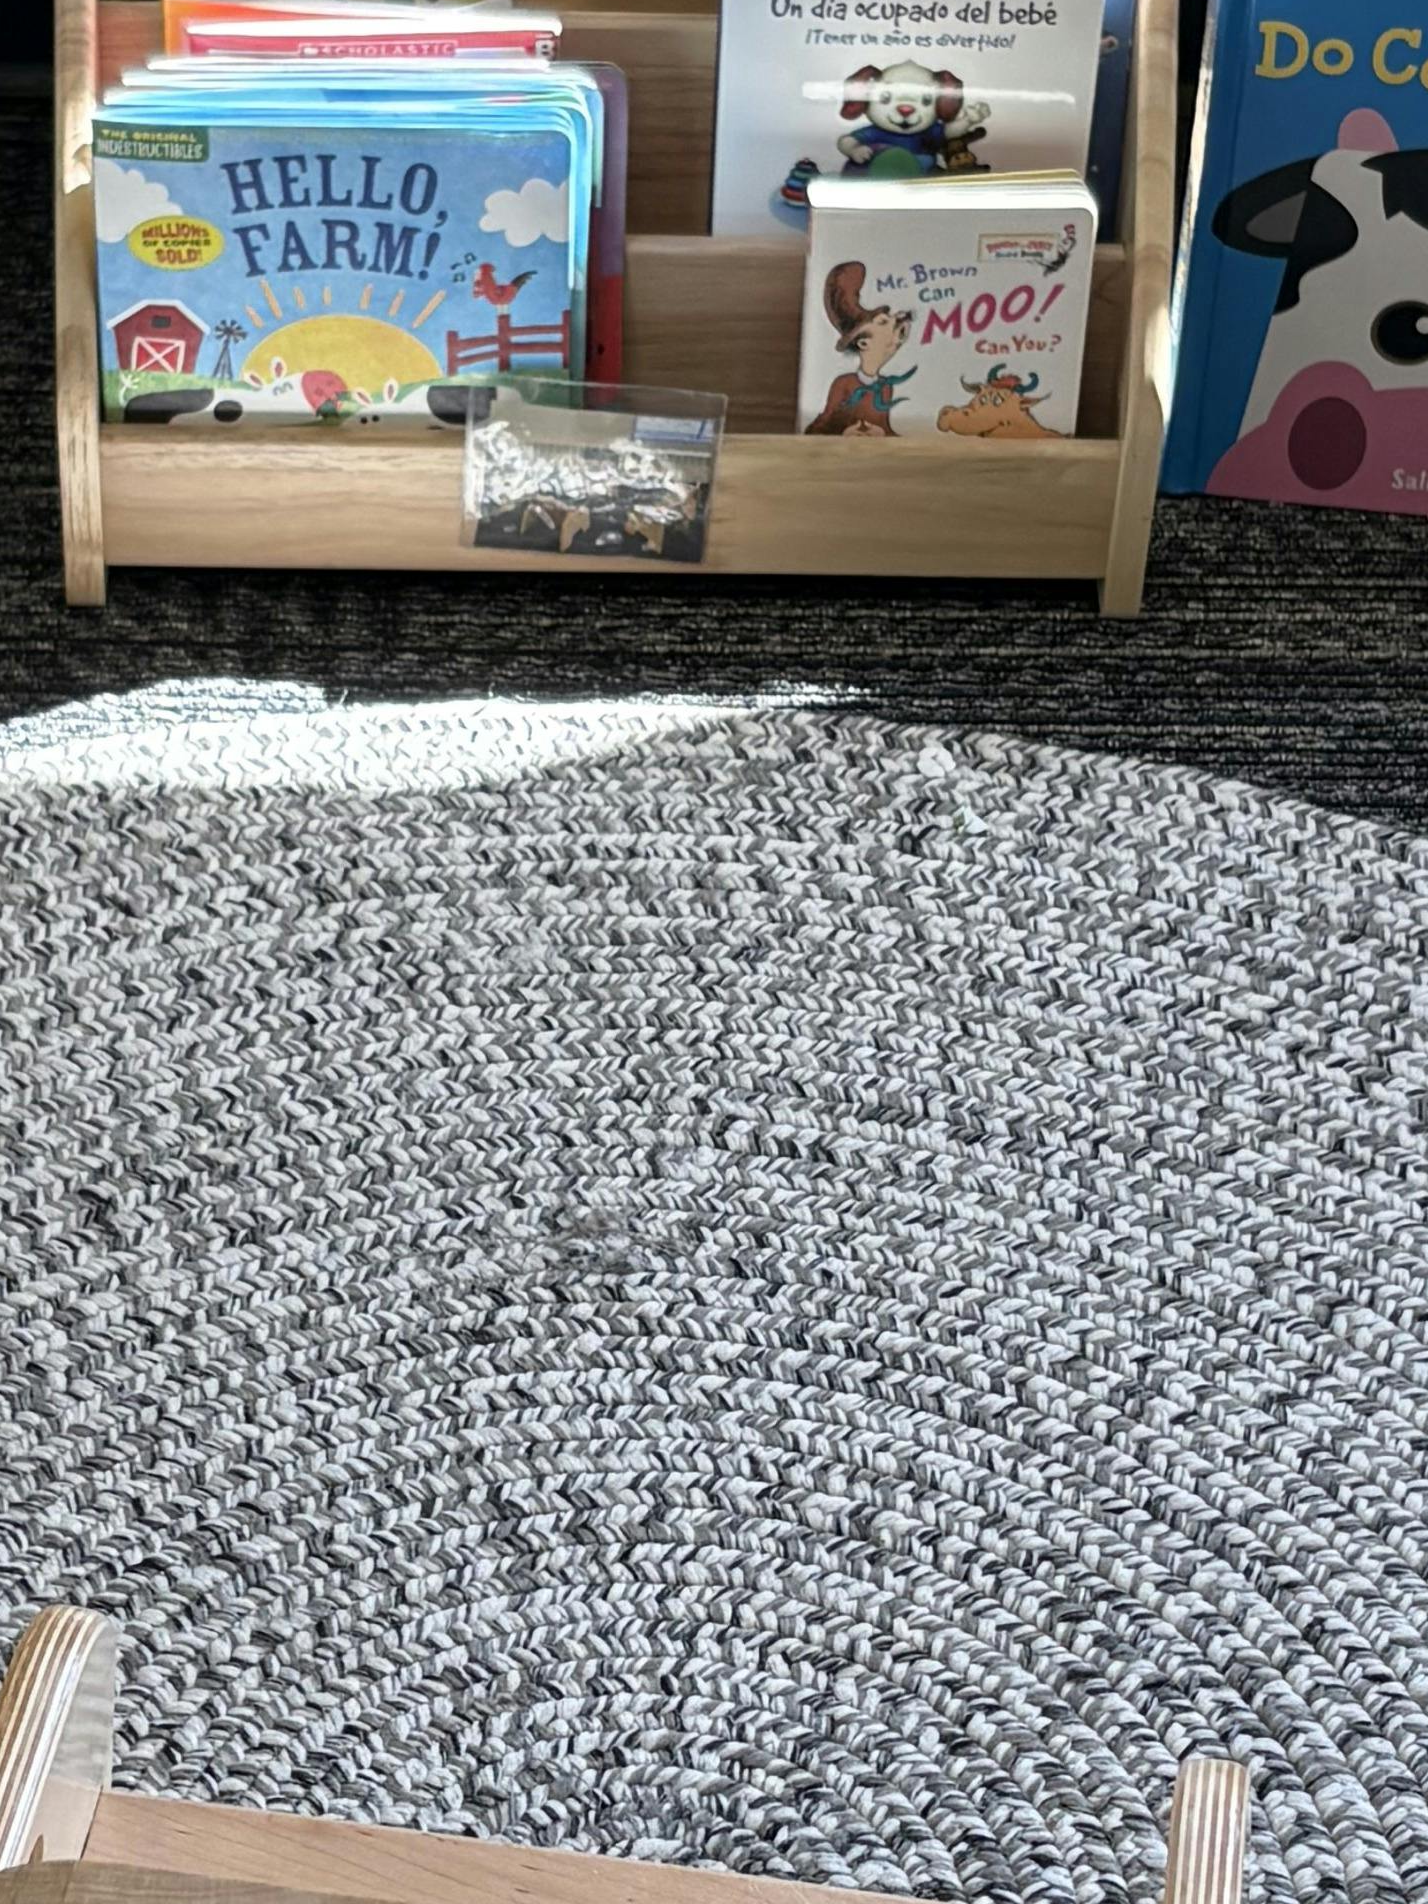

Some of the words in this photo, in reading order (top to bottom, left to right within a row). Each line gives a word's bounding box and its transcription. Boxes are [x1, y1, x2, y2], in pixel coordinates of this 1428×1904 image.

[854, 0, 949, 26] ocupado
[955, 1, 990, 24] del
[998, 1, 1057, 26] bebé
[861, 33, 879, 46] un
[883, 29, 911, 47] año
[915, 34, 933, 47] es
[1255, 21, 1355, 79] Do
[101, 129, 127, 139] THE
[132, 130, 197, 143] ORIGINAL
[97, 138, 204, 159] INDESTRUCTIBLES
[220, 152, 449, 227] HELLO,
[141, 222, 210, 239] MILLIONS
[142, 239, 157, 247] OF
[162, 239, 211, 248] COPIES
[233, 218, 442, 281] FARM!
[155, 248, 203, 264] SOLD!
[876, 273, 909, 292] Mr.
[910, 264, 977, 284] Brown
[920, 284, 1065, 345] MOO!
[1010, 334, 1062, 354] You?
